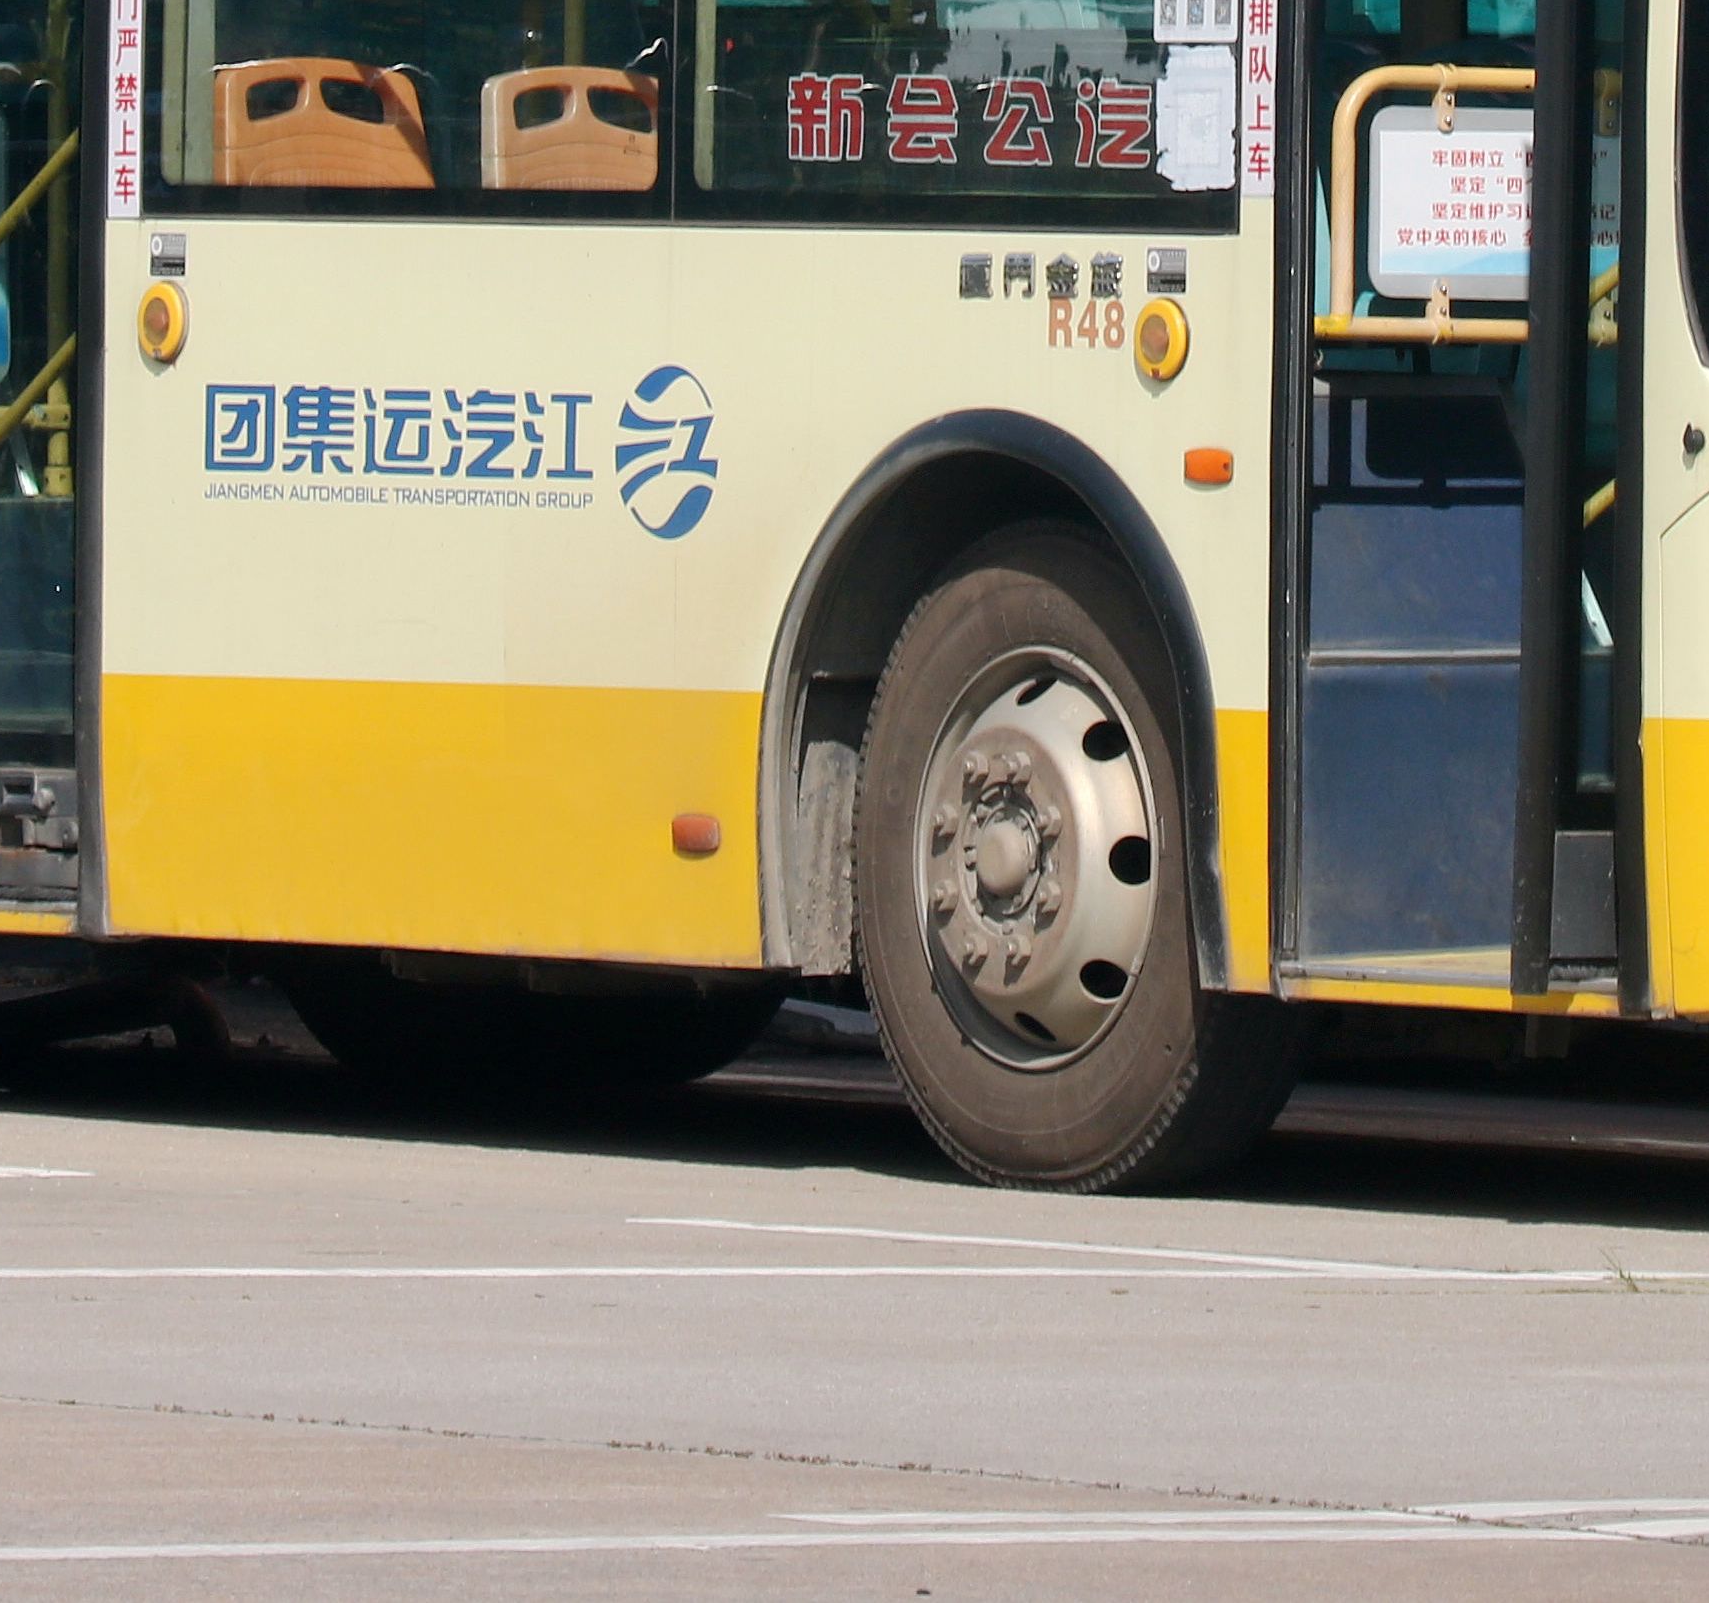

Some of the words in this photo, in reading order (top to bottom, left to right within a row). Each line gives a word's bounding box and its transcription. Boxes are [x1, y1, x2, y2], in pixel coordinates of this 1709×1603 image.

[787, 72, 1155, 169] 新会公汽
[1397, 229, 1507, 247] 党中央的核心
[1048, 299, 1126, 349] R48
[204, 483, 285, 501] JIANGMEN
[290, 485, 388, 504] AUTOMOBILE
[393, 487, 530, 508] TRANSPORTATION
[535, 492, 594, 509] GROUP
